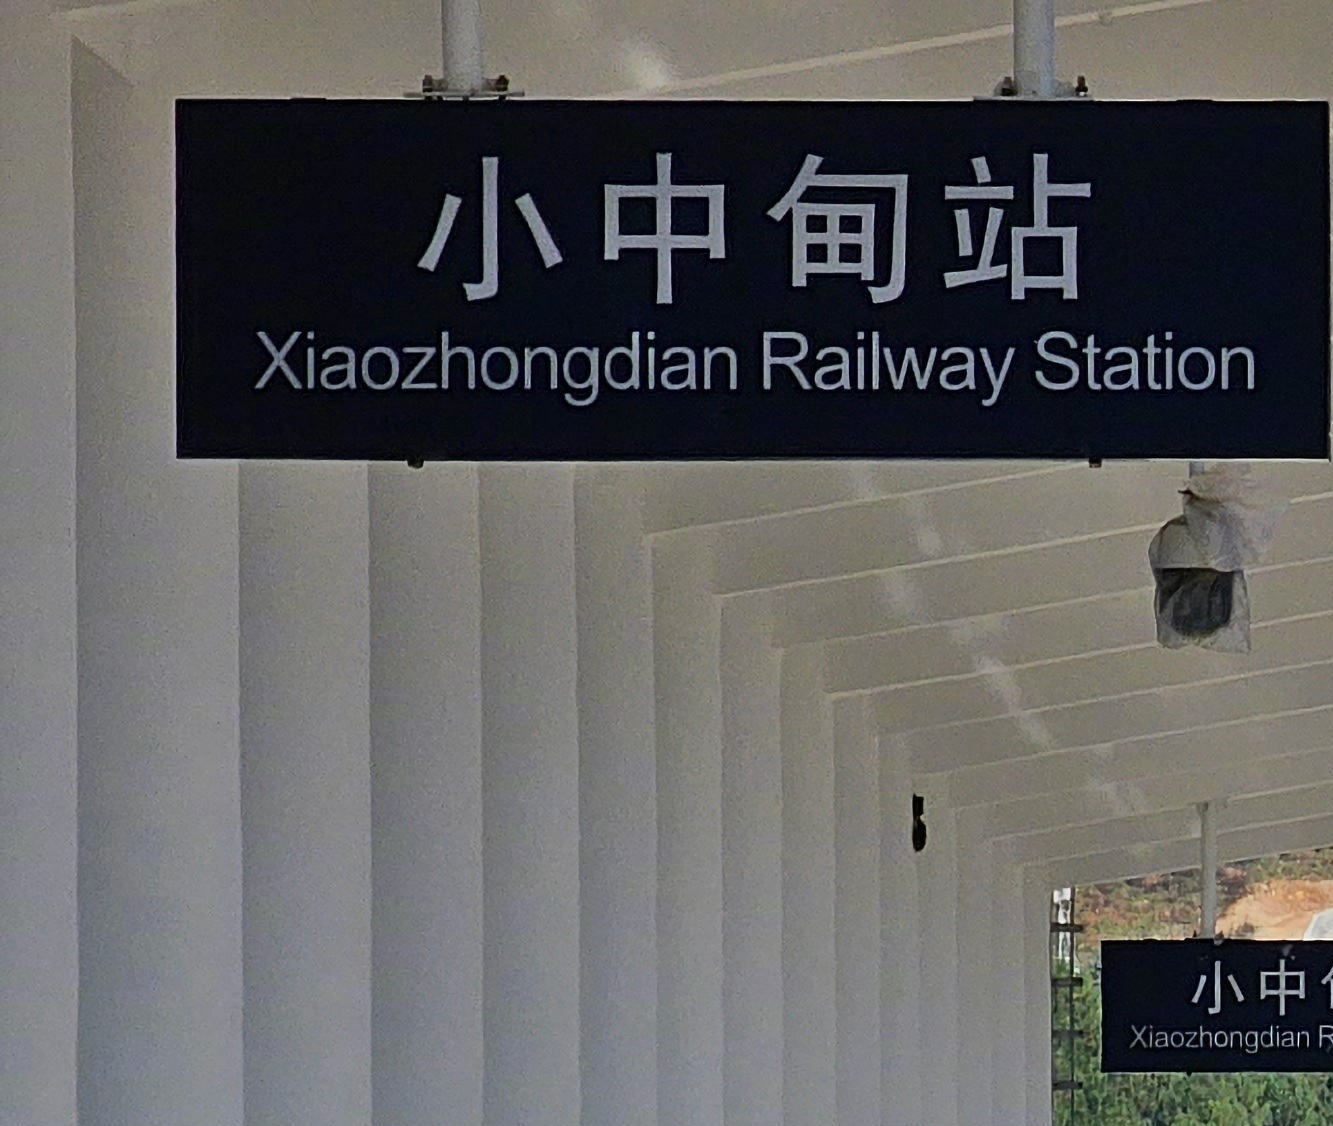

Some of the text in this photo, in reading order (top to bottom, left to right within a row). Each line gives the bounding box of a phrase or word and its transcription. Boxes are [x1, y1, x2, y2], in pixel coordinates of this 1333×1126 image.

[418, 152, 1092, 304] 小中甸站
[255, 330, 1255, 407] Xiaozhongdian Railway Station
[1130, 1025, 1310, 1054] Xiaozhongdian
